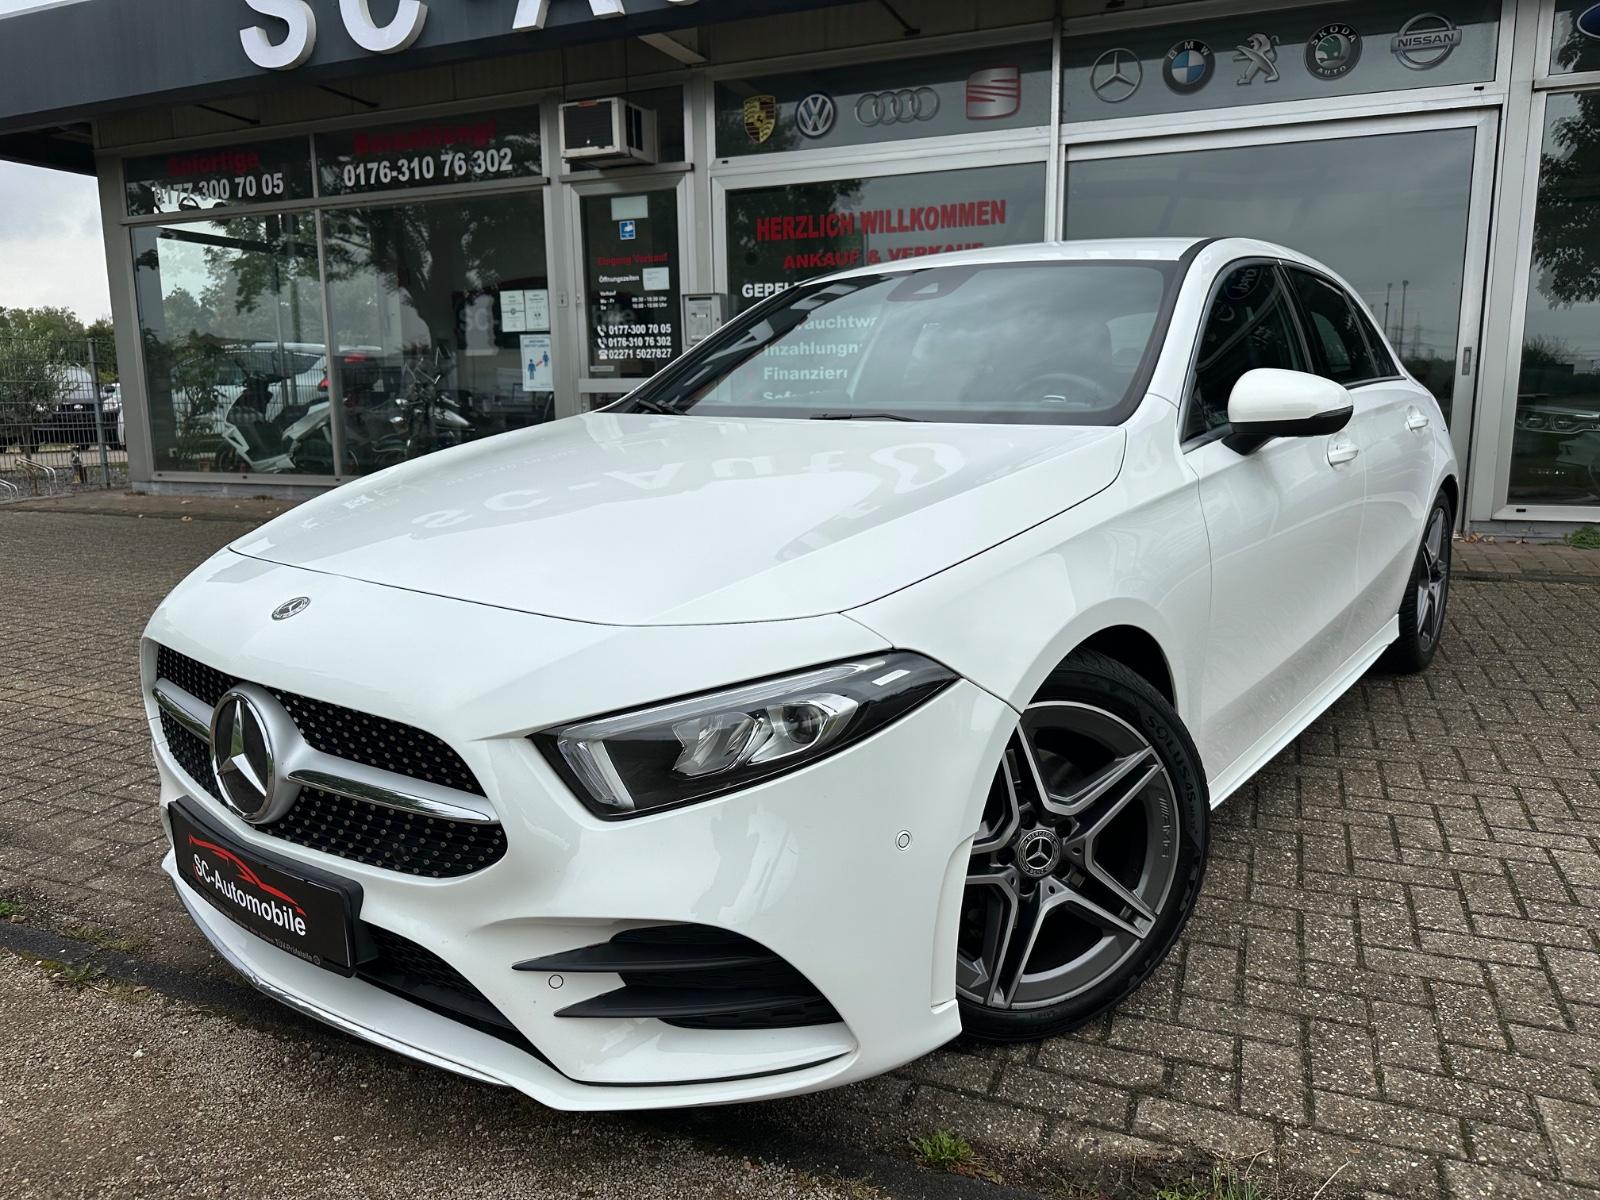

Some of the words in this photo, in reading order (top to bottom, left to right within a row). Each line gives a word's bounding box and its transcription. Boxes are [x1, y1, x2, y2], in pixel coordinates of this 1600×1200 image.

[1167, 41, 1210, 60] BMW
[1397, 32, 1455, 48] NISSAN
[343, 156, 434, 187] 0176-310
[440, 152, 467, 177] 76
[473, 148, 513, 174] 302
[154, 178, 230, 205] 0177-300
[234, 175, 257, 198] 70
[261, 172, 284, 195] 05
[757, 211, 854, 241] HERZLICH
[860, 200, 1007, 234] WILLKOMMEN
[784, 251, 860, 269] ANKAUF
[869, 248, 881, 264] &
[608, 324, 646, 335] 0177-300
[648, 323, 659, 334] 70
[660, 323, 672, 334] 05
[608, 337, 643, 347] 0176-310
[644, 336, 655, 346] 76
[656, 336, 672, 346] 302
[608, 349, 633, 359] 02271
[1146, 715, 1190, 780] SOLUS
[193, 853, 307, 936] SC-Automobile
